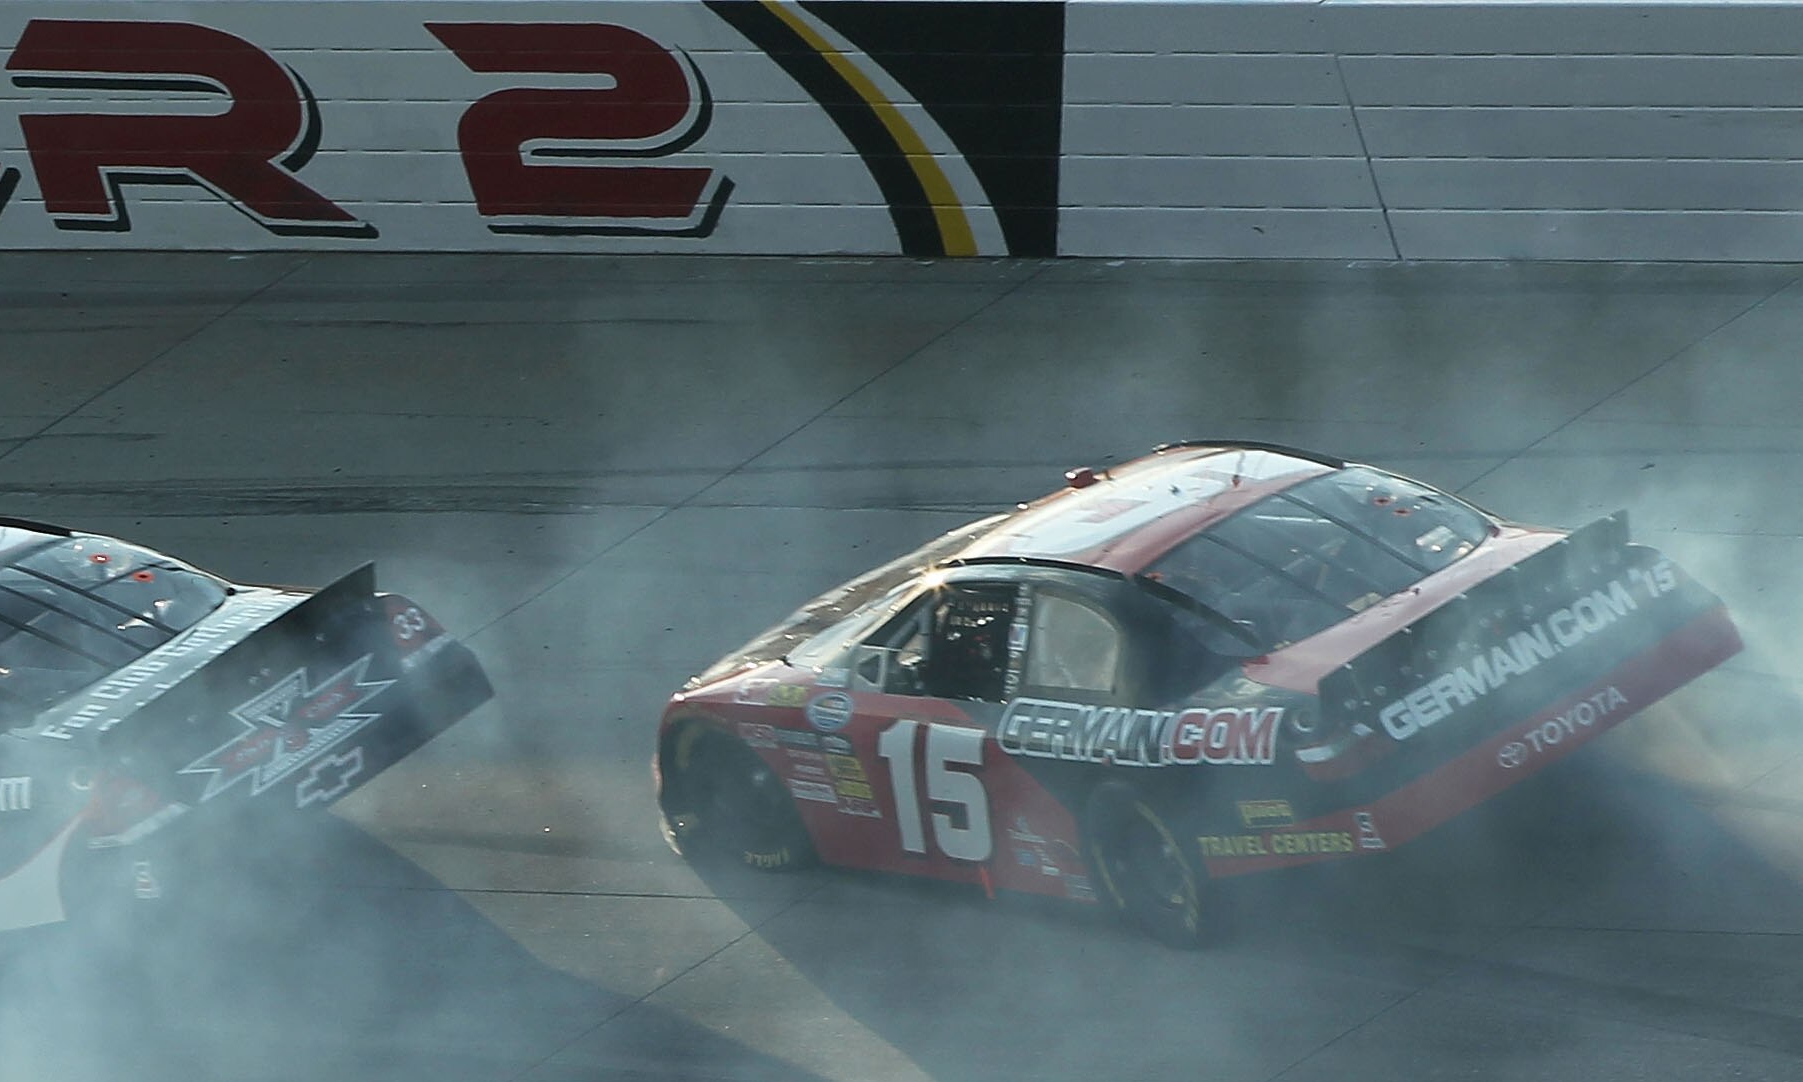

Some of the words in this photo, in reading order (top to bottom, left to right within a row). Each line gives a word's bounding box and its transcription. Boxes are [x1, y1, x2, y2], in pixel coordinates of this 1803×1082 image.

[423, 22, 736, 238] 2
[393, 606, 426, 640] 33
[90, 659, 169, 700] Club
[1379, 580, 1638, 741] GERMAIN.COM
[1525, 685, 1628, 753] TOYOTA
[878, 719, 993, 862] 15
[1197, 835, 1269, 857] TRAVEL
[1270, 831, 1354, 854] CENTERS
